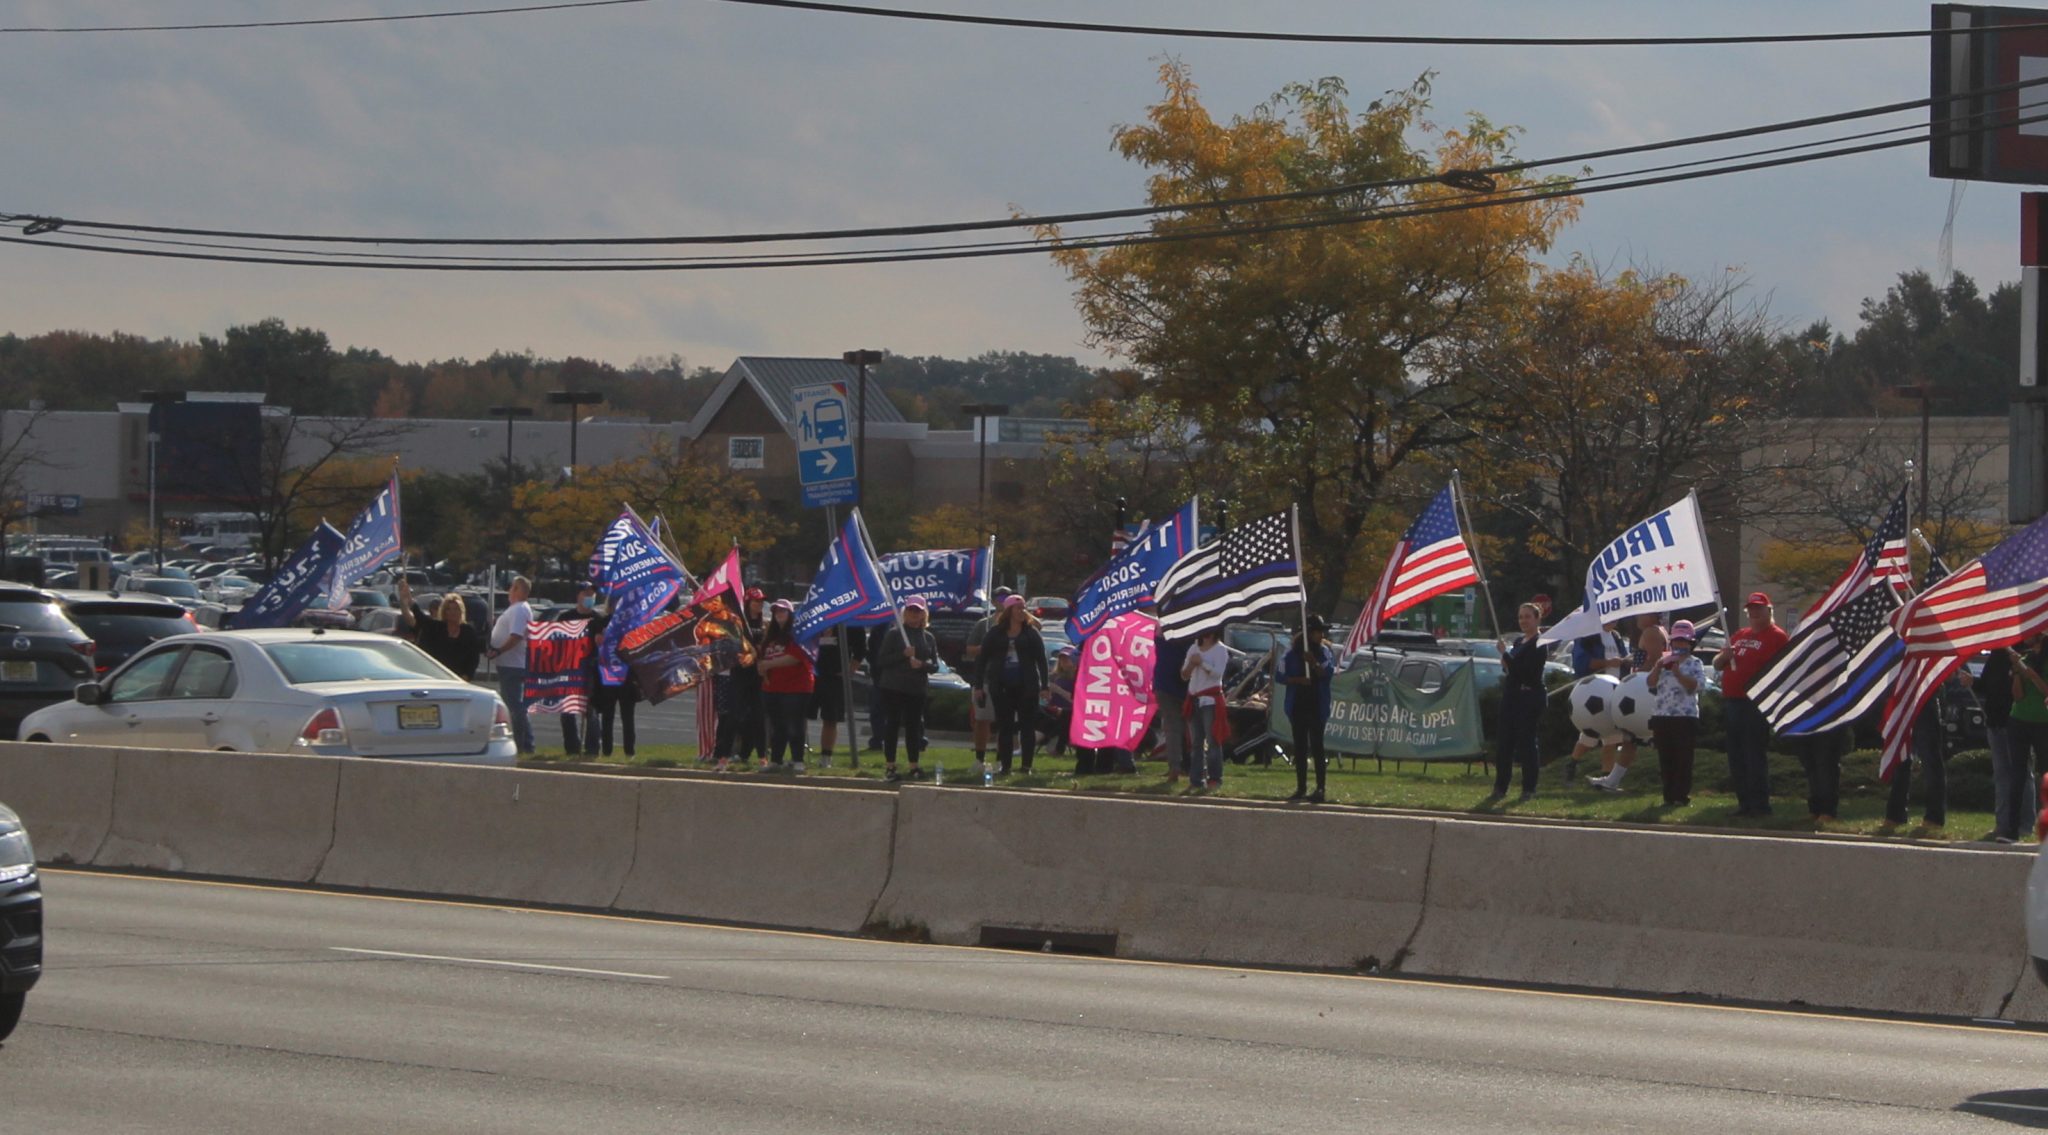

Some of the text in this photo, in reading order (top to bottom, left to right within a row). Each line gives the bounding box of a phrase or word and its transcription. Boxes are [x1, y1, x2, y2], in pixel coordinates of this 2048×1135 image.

[1390, 705, 1417, 727] ARE
[1422, 707, 1456, 729] OPEN
[1347, 725, 1359, 741] TO
[1386, 729, 1403, 743] YOU
[1405, 731, 1438, 745] AGAIN
